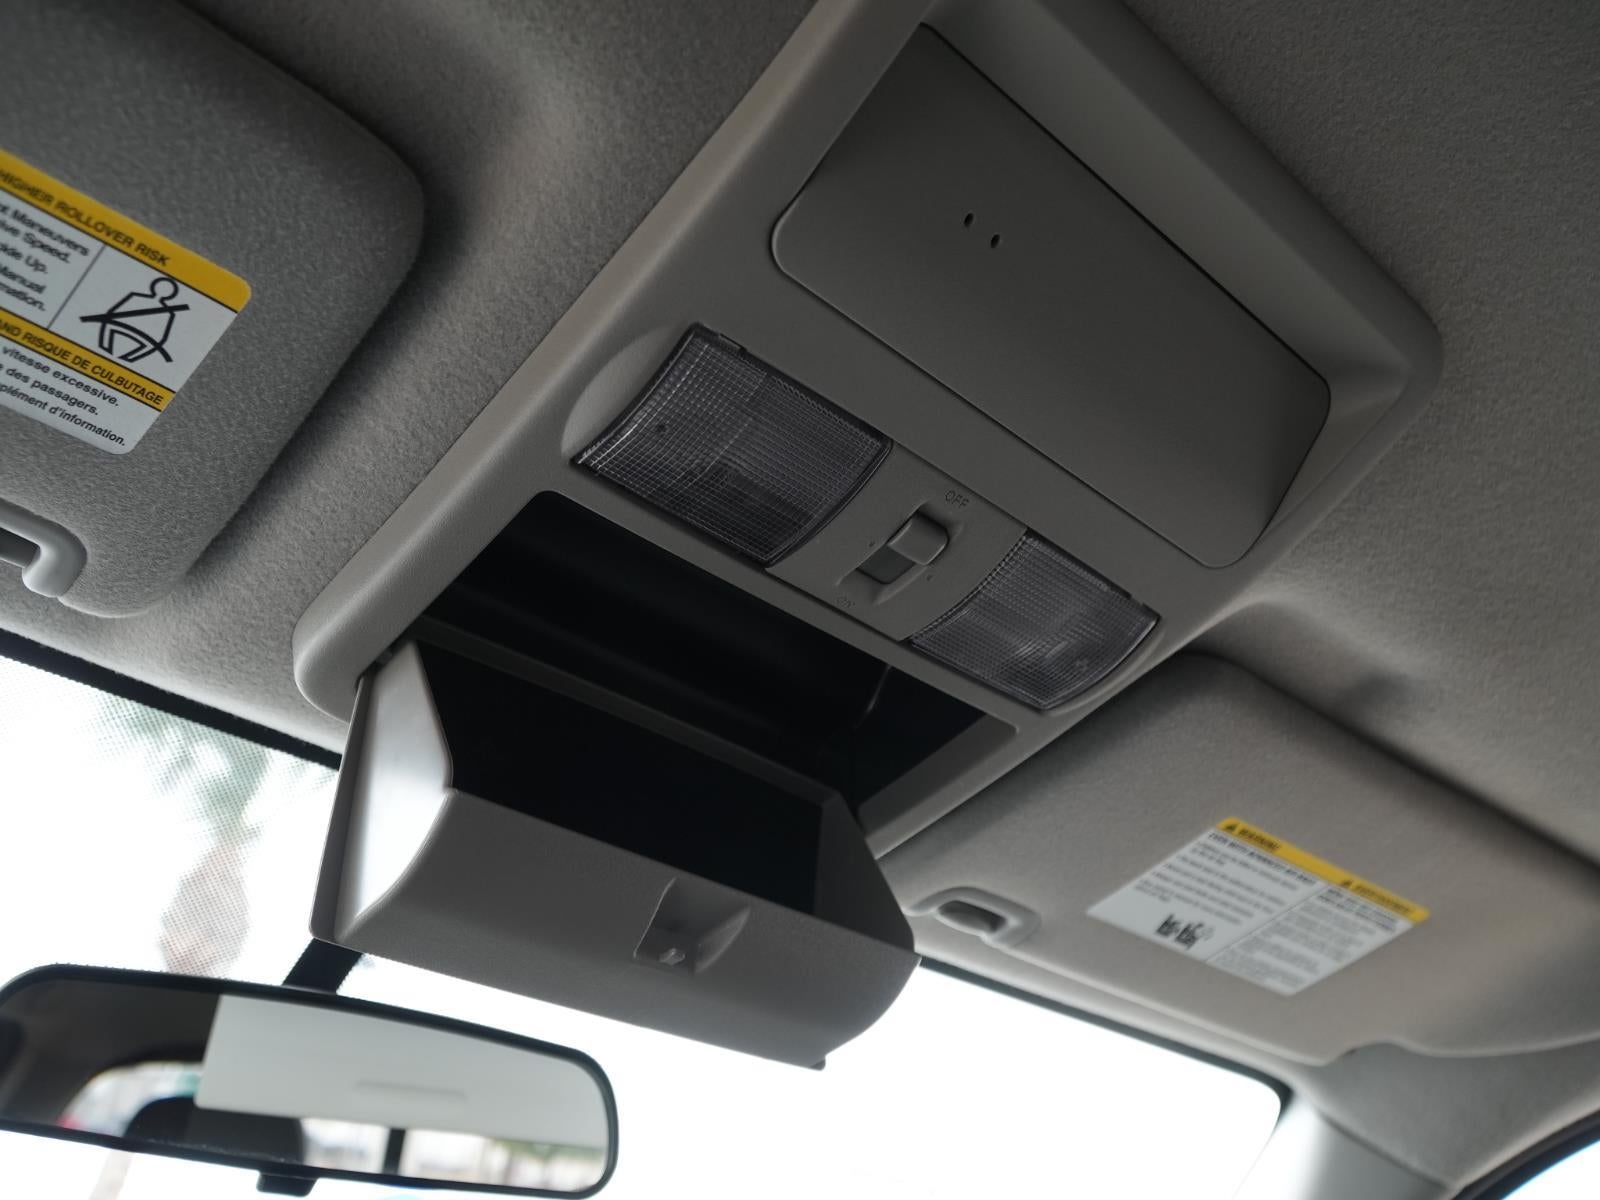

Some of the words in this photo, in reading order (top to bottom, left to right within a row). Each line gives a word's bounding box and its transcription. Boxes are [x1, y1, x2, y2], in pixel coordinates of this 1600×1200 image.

[11, 209, 90, 256] Maneuvers
[23, 232, 70, 264] Speed.
[55, 200, 135, 249] ROLLOVER
[135, 243, 171, 267] RISK
[25, 255, 48, 274] Up.
[2, 345, 51, 374] vitesse
[52, 367, 120, 407] excessive.
[6, 364, 30, 384] des
[30, 378, 99, 416] passagers.
[21, 328, 71, 363] RISQUE
[71, 353, 91, 371] DE
[91, 364, 165, 406] CULBUTAGE
[48, 402, 126, 447] d'information.
[945, 490, 970, 509] OFF
